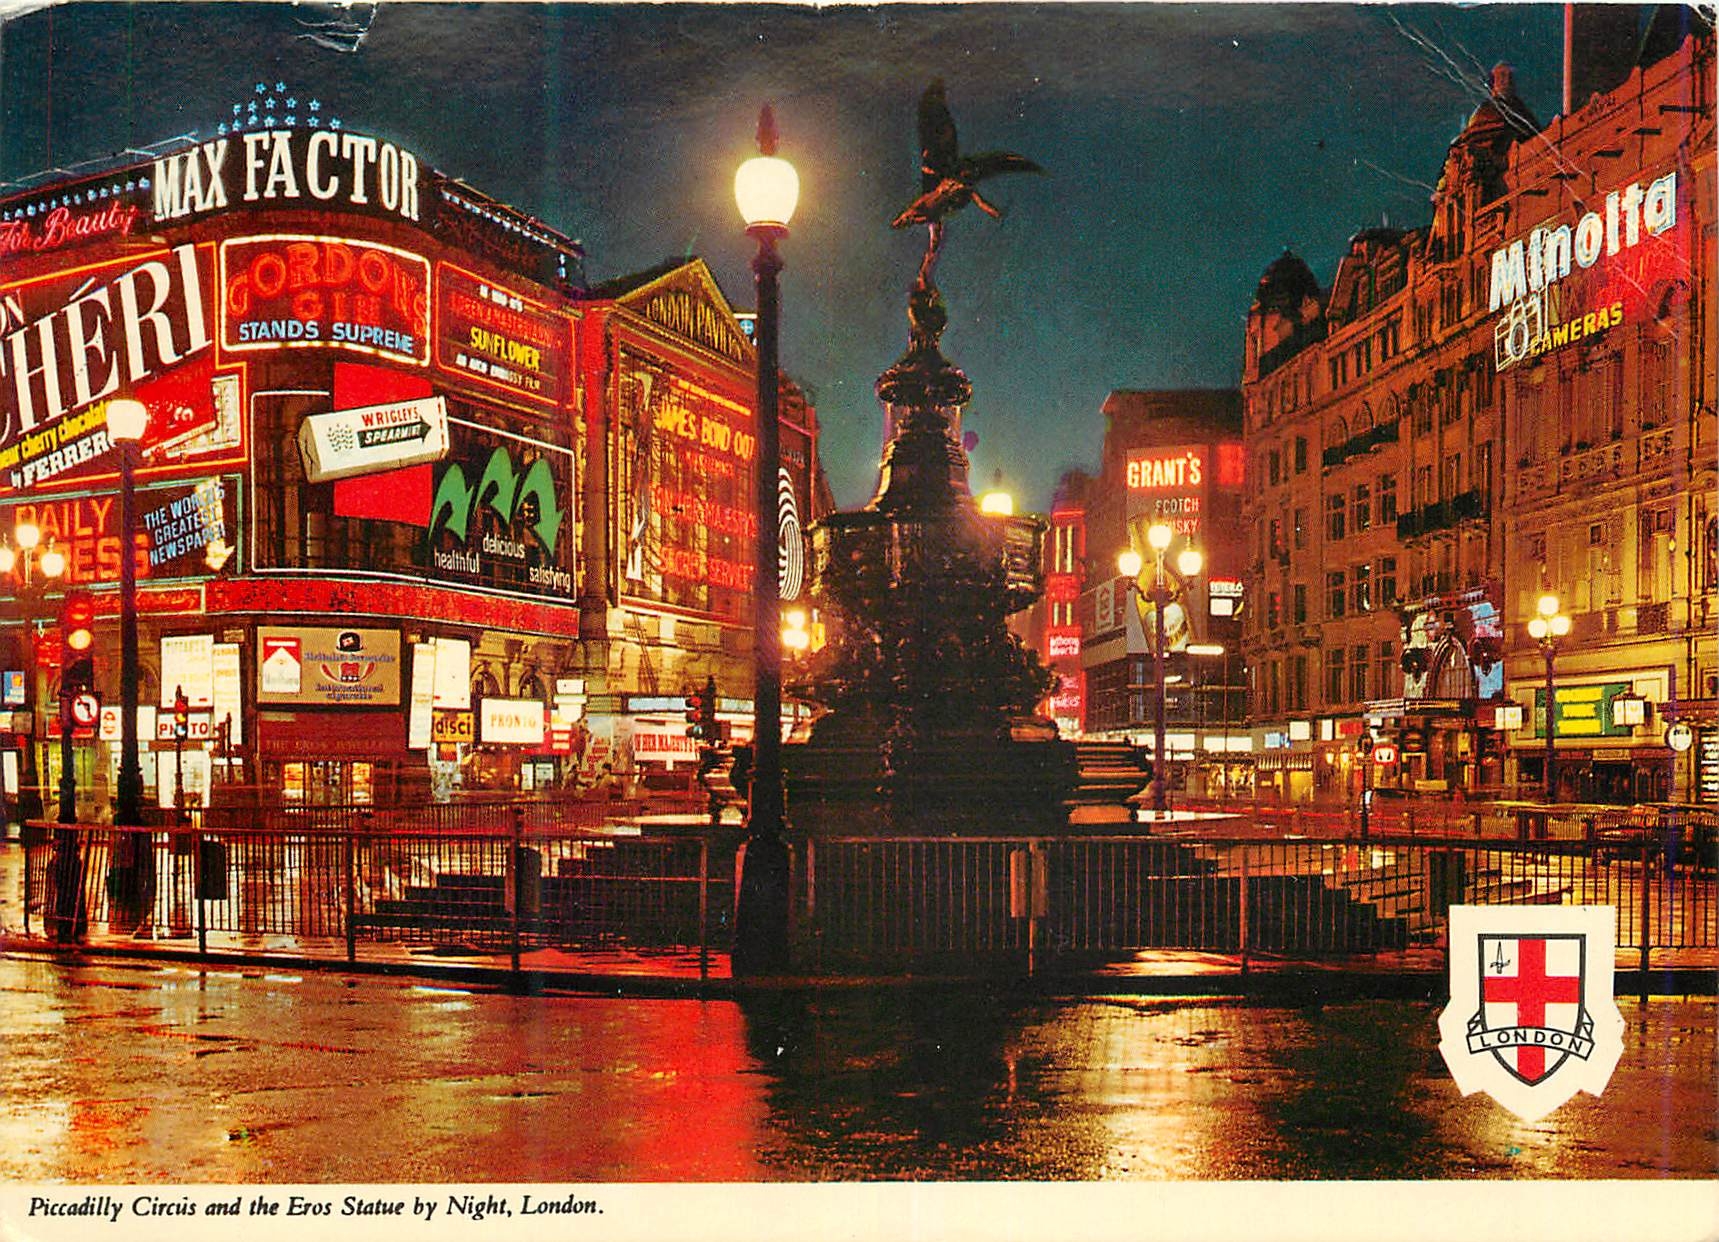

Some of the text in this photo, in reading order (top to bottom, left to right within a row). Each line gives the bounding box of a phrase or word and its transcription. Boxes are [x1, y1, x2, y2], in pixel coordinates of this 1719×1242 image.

[154, 129, 420, 223] MAX FACTOR
[33, 200, 139, 252] Beauty
[1489, 171, 1676, 312] Minolta
[292, 291, 383, 323] GIN
[239, 319, 414, 354] STANDS SUPREME
[1530, 302, 1624, 355] CAMERAS
[470, 326, 540, 372] SUNFLOWER
[701, 416, 731, 451] BOND
[733, 431, 755, 460] 007
[22, 430, 117, 488] FERRER
[1127, 452, 1201, 488] GRANT'S
[15, 497, 114, 541] DAILY
[144, 507, 168, 530] THE
[1155, 496, 1199, 514] SCOTCH
[150, 520, 226, 567] NEWSPAPER
[434, 549, 480, 574] healthful
[482, 533, 526, 559] delicious
[529, 565, 571, 594] satisfying
[159, 722, 209, 736] PTO
